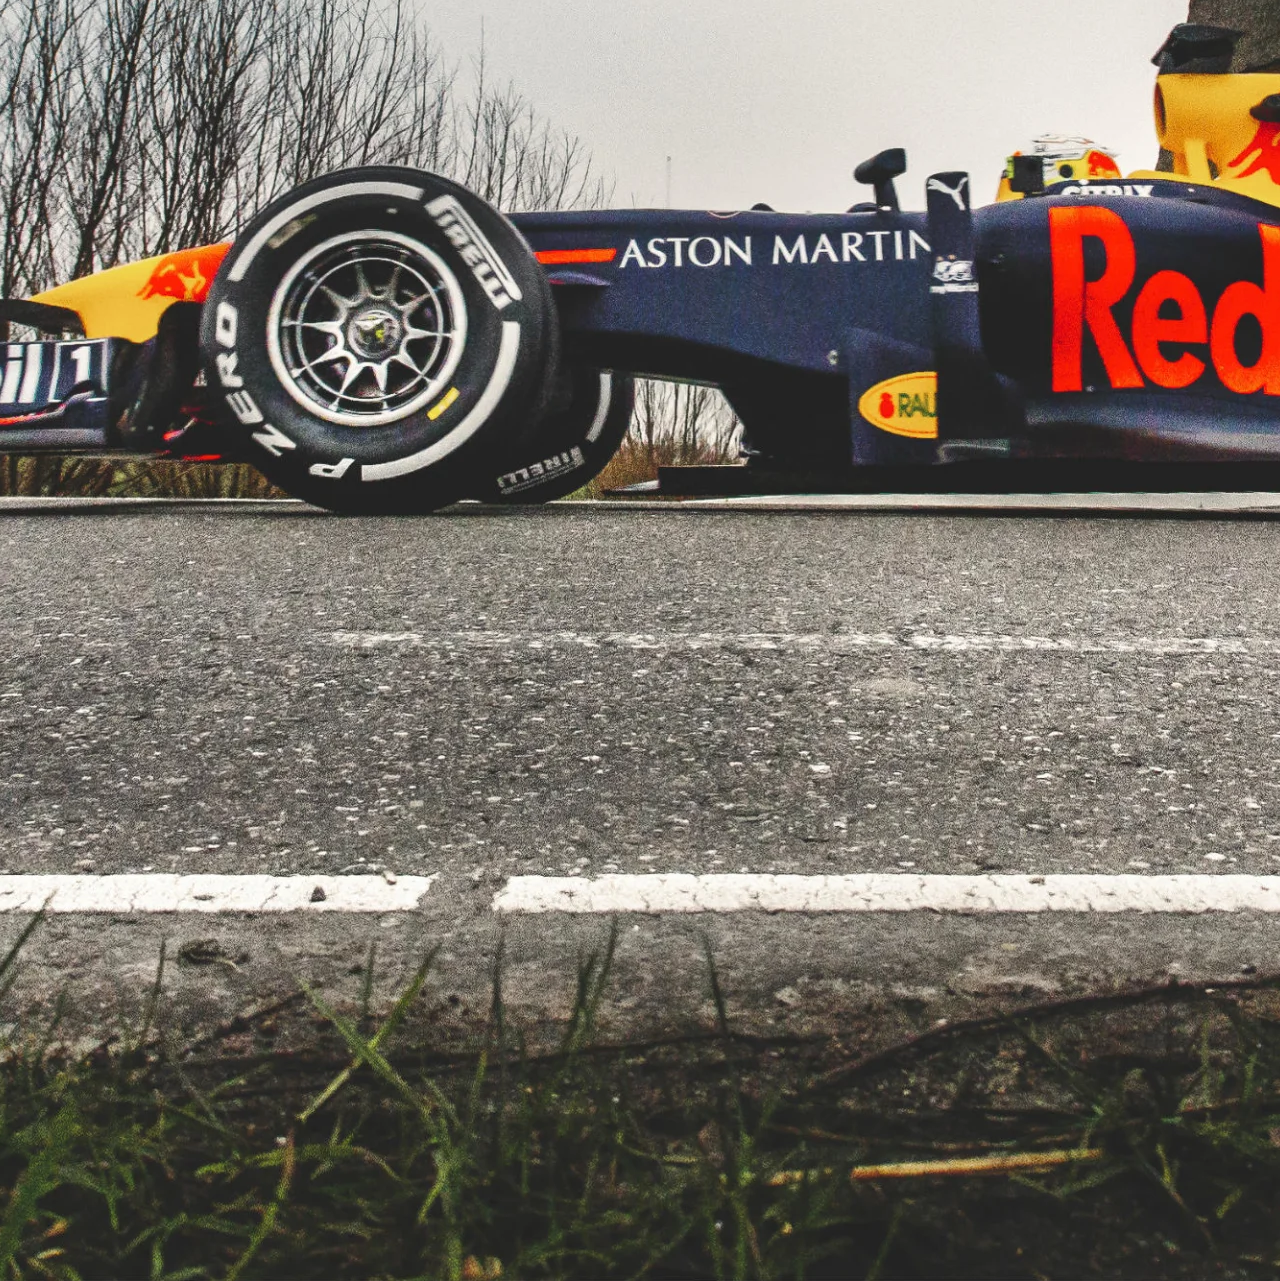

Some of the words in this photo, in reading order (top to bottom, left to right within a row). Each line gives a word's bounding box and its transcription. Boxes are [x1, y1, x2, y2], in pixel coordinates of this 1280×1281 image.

[424, 194, 523, 310] PIRELLI
[620, 236, 753, 268] ASTON
[772, 229, 932, 265] MARTIN
[70, 346, 91, 385] 1
[215, 301, 297, 456] ZERO
[309, 457, 355, 479] P
[497, 446, 585, 494] PIRELLI
